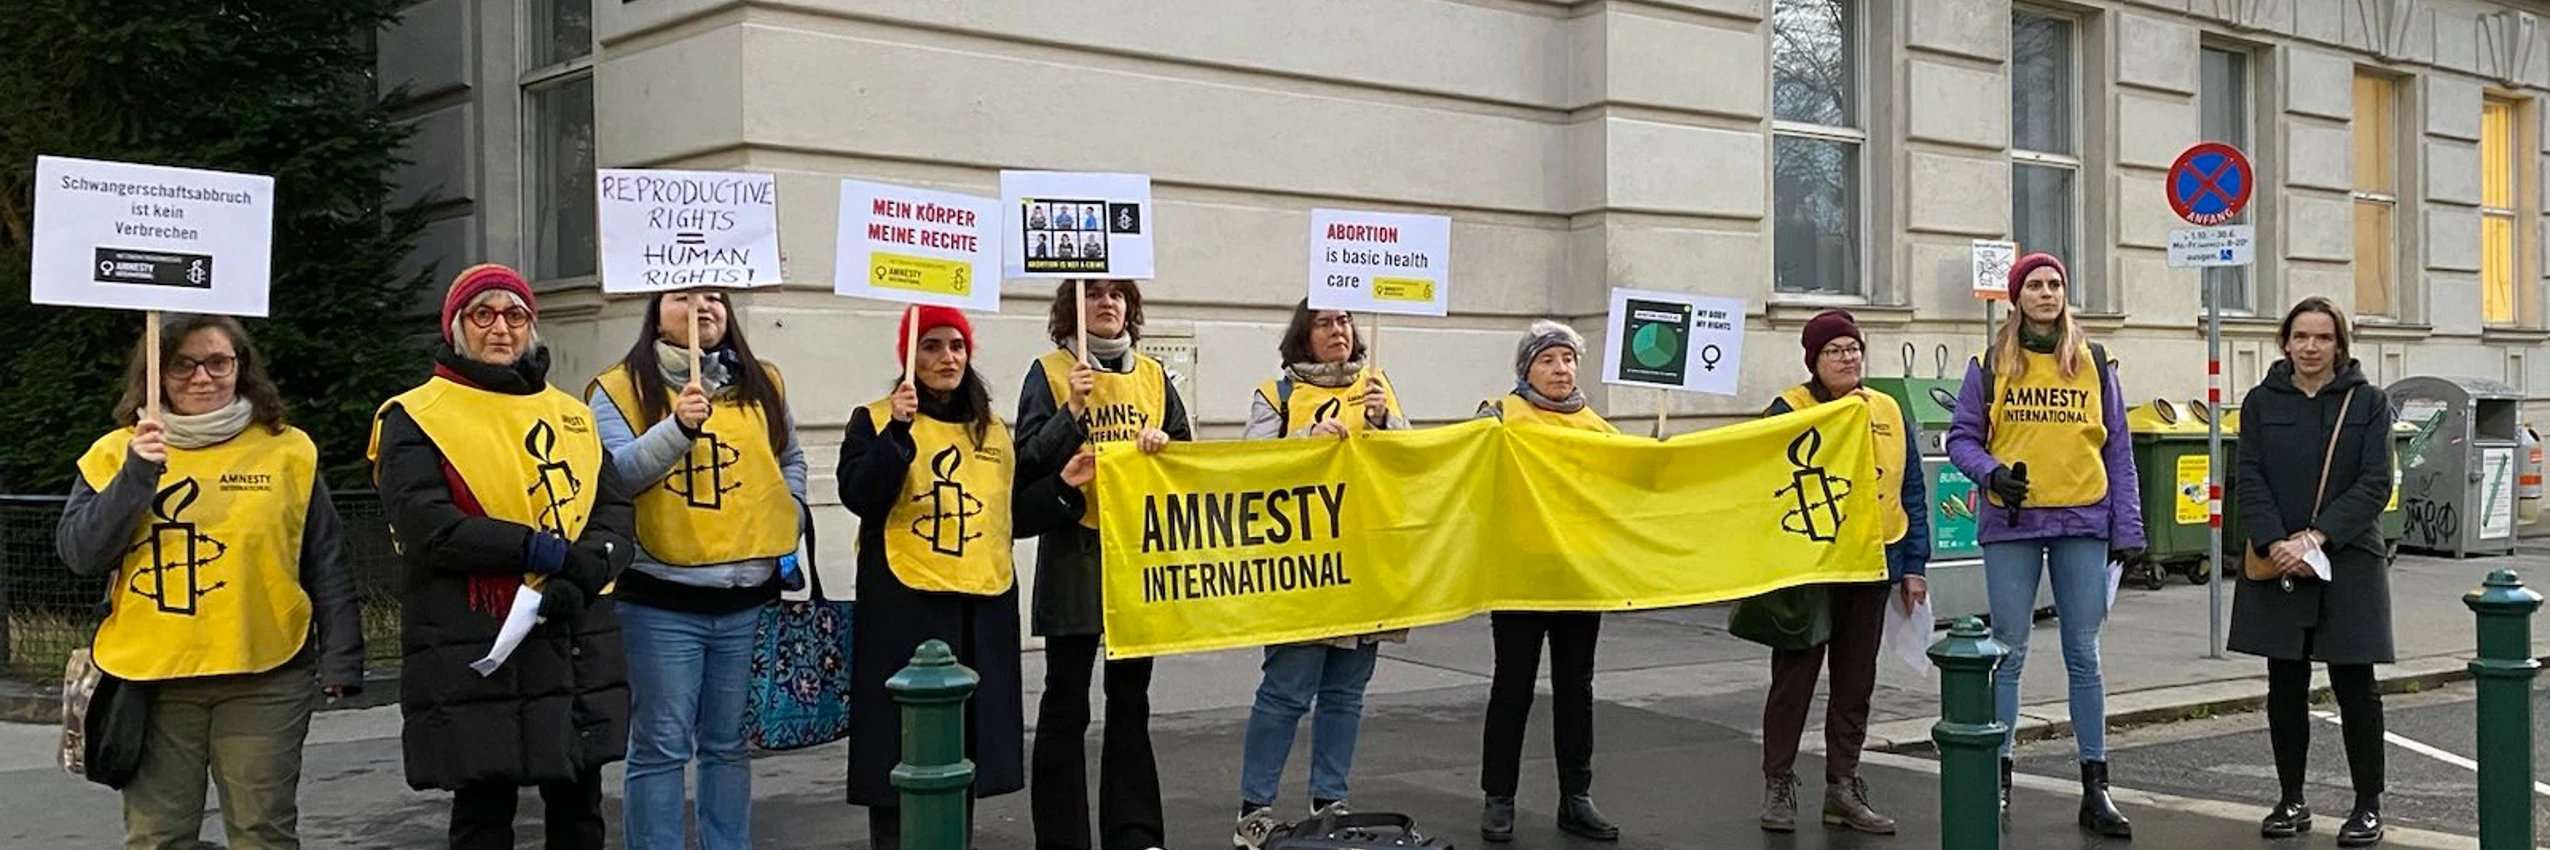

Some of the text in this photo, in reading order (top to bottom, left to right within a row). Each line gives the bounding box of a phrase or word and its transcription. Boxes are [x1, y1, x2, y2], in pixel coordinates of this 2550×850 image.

[62, 176, 251, 204] Schwangerschaftsabbruch
[602, 176, 773, 205] REPRODUCTIVE
[131, 203, 183, 219] ist kein
[648, 207, 736, 231] RIGHTS
[873, 198, 976, 228] MEIN KÖRPER
[2186, 207, 2234, 224] ANFANG
[116, 222, 198, 240] Verbrechen
[868, 223, 978, 252] MEINE RECHTE
[1327, 223, 1398, 243] ABORTION
[643, 244, 750, 265] HUMAN
[1326, 246, 1428, 269] is basic health
[642, 268, 755, 287] RIGHTS!
[1327, 274, 1360, 288] care
[2003, 387, 2089, 408] AMNESTY
[2003, 408, 2089, 423] INTERNATIONAL
[220, 474, 271, 484] AMNESTY
[1142, 482, 1346, 553] AMNESTY
[1143, 551, 1352, 603] INTERNATIONAL
